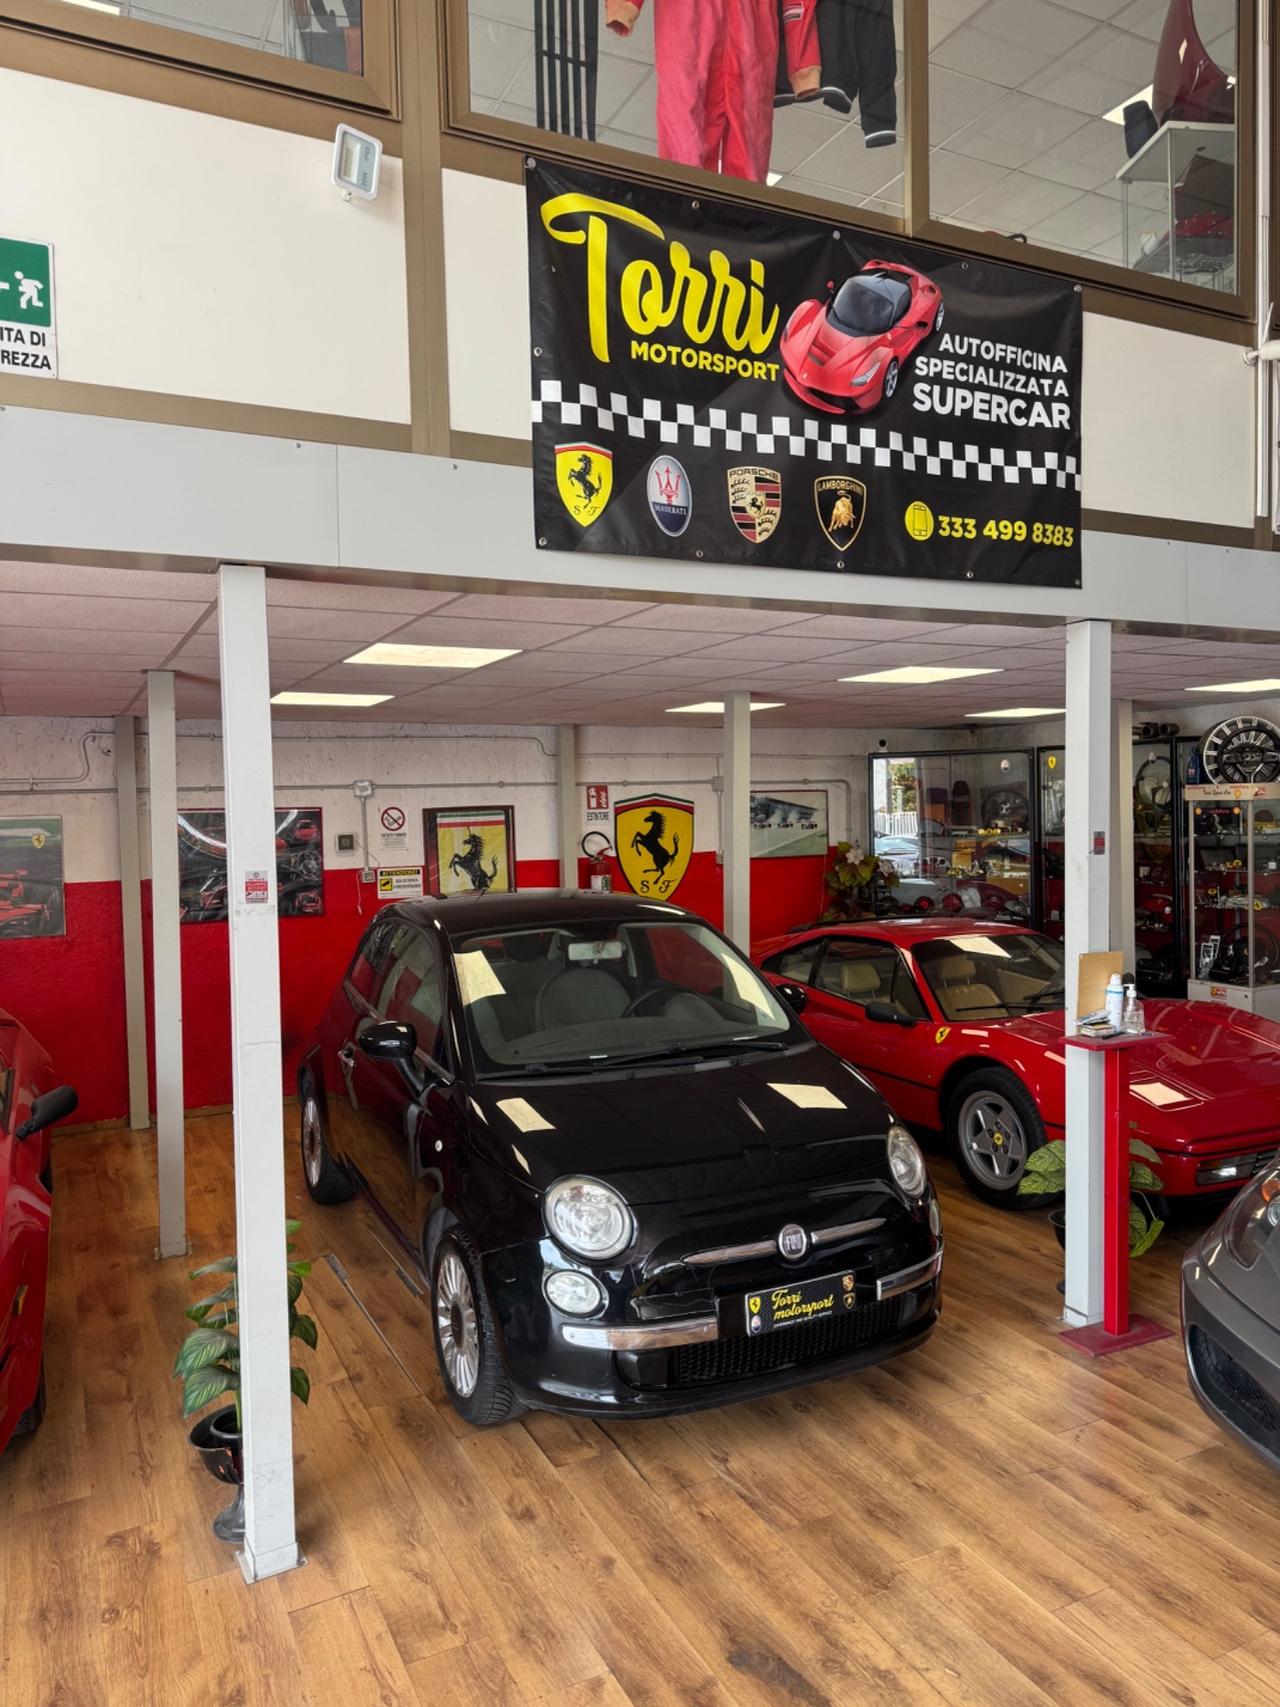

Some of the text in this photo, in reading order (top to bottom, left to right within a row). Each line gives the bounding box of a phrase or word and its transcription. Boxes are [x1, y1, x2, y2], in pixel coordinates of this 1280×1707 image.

[540, 192, 780, 363] Torri
[30, 330, 46, 347] DI
[1, 349, 52, 370] REZZA
[630, 340, 780, 382] MOTORSPORT
[938, 333, 1068, 373] AUTOFFICINA
[914, 355, 1070, 397] SPECIALIZZATA
[912, 382, 1071, 430] SUPERCAR
[728, 467, 780, 482] PORSCHE
[817, 479, 863, 496] LAMBORGHINI
[653, 503, 688, 516] MASERATI
[938, 515, 1074, 548] 333 499 8383
[640, 880, 650, 893] S
[771, 1289, 802, 1309] Torri
[773, 1294, 834, 1320] motorsport
